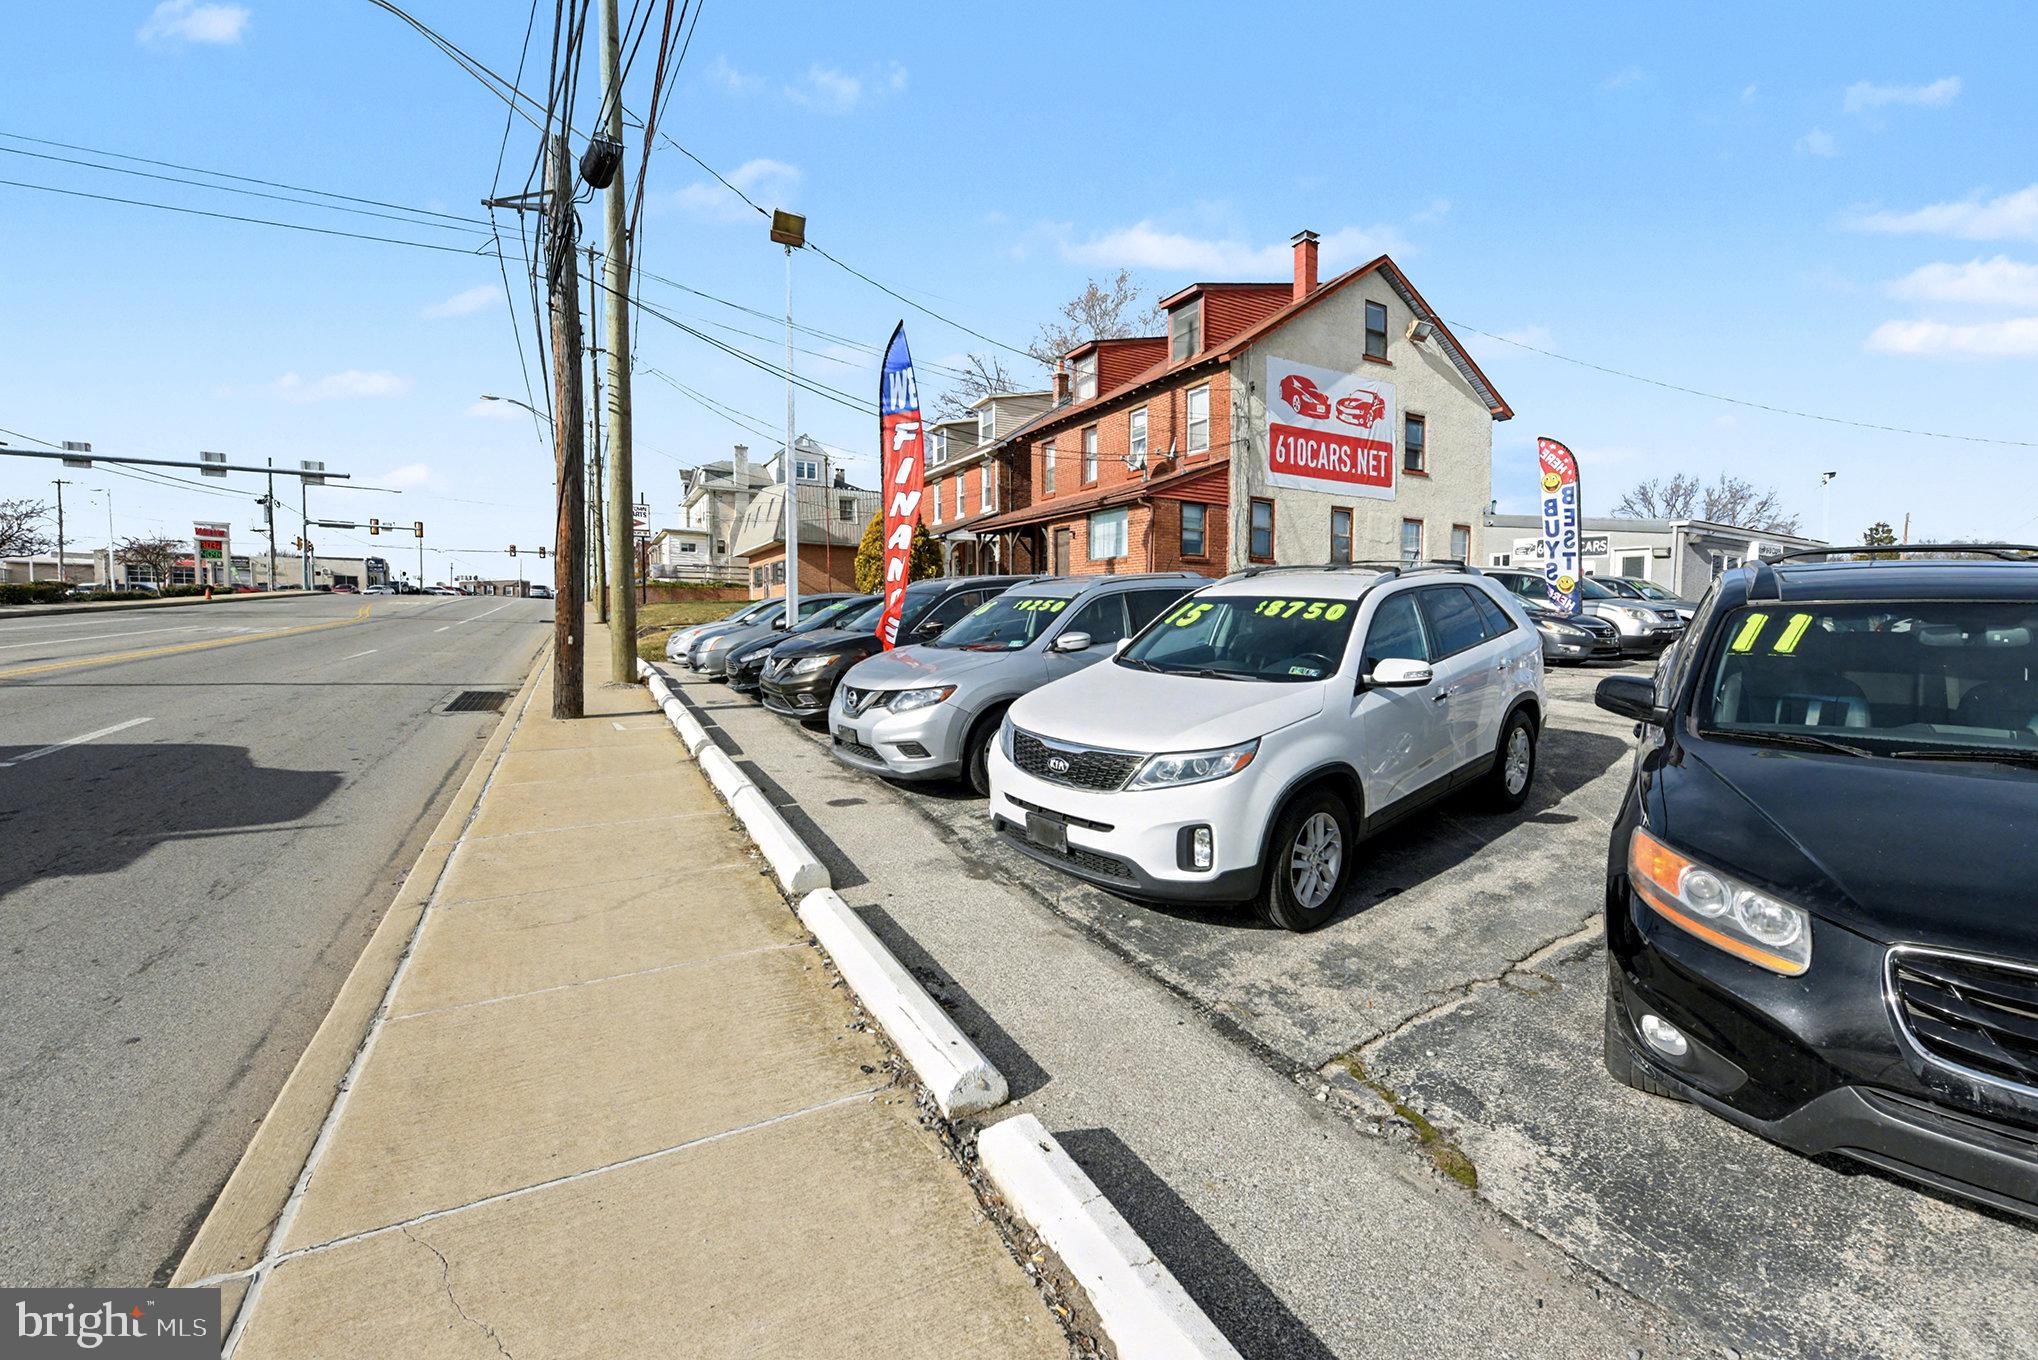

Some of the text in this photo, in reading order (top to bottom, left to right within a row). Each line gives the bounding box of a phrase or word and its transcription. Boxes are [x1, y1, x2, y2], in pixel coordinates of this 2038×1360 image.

[1275, 434, 1388, 478] 610CARS.NET
[1164, 602, 1214, 627] 15
[1255, 600, 1347, 621] $8750
[1732, 613, 1813, 653] 11
[1049, 759, 1065, 770] KIA
